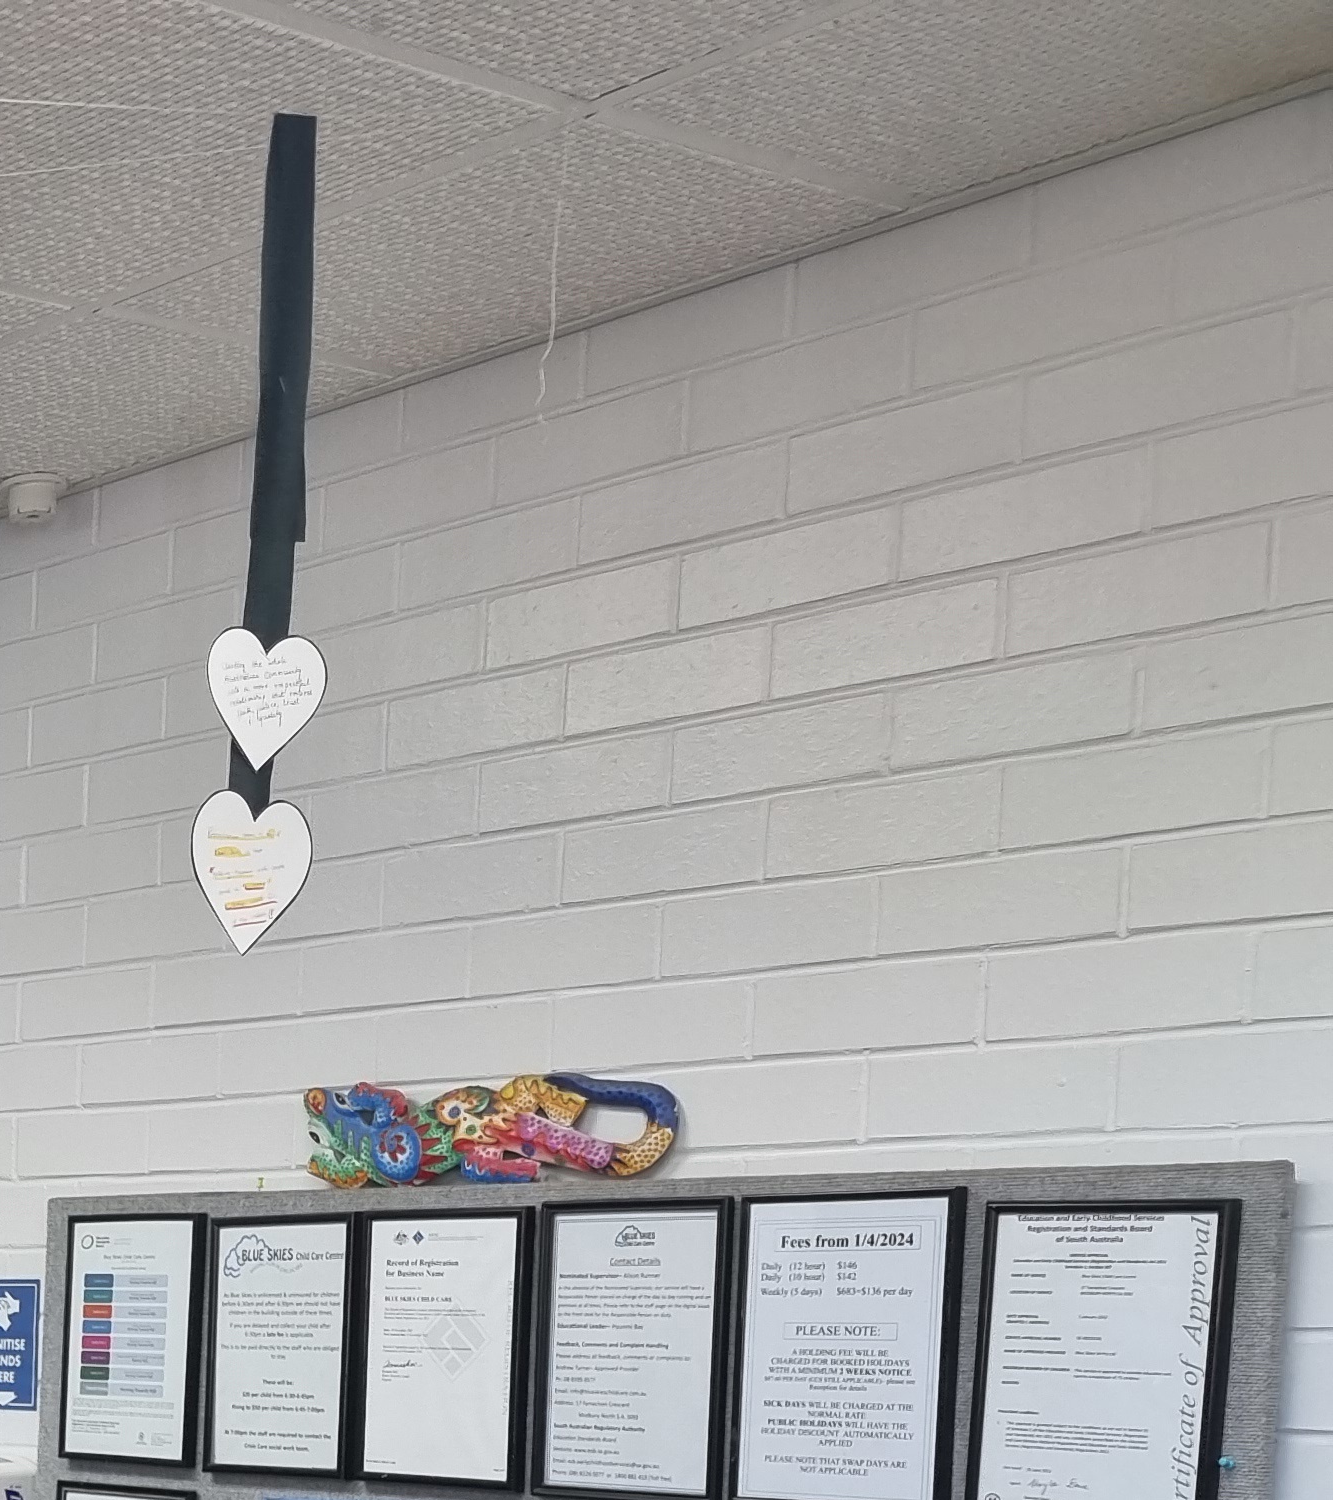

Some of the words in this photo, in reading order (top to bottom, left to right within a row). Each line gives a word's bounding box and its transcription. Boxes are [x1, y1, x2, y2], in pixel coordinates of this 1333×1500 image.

[781, 1235, 811, 1248] Fees
[815, 1235, 849, 1248] from
[854, 1233, 914, 1247] 1/4/2024
[242, 1249, 264, 1261] BLUE
[268, 1248, 293, 1261] SKIES
[296, 1252, 310, 1260] Child
[311, 1252, 323, 1260] Care
[420, 1259, 459, 1267] Registration
[761, 1263, 782, 1271] Daily
[789, 1262, 802, 1270] (12
[804, 1262, 825, 1270] hour)
[837, 1261, 857, 1270] $146
[761, 1273, 782, 1282] Daily
[789, 1273, 802, 1282] (10
[804, 1273, 825, 1281] hour)
[837, 1272, 857, 1281] $142
[1183, 1216, 1211, 1345] Approval
[761, 1288, 788, 1298] Weekly
[791, 1288, 799, 1297] (5
[801, 1288, 822, 1297] days)
[883, 1289, 895, 1297] per
[899, 1288, 913, 1297] day
[796, 1326, 840, 1336] PLEASE
[844, 1326, 881, 1336] NOTE:
[1179, 1353, 1205, 1385] of
